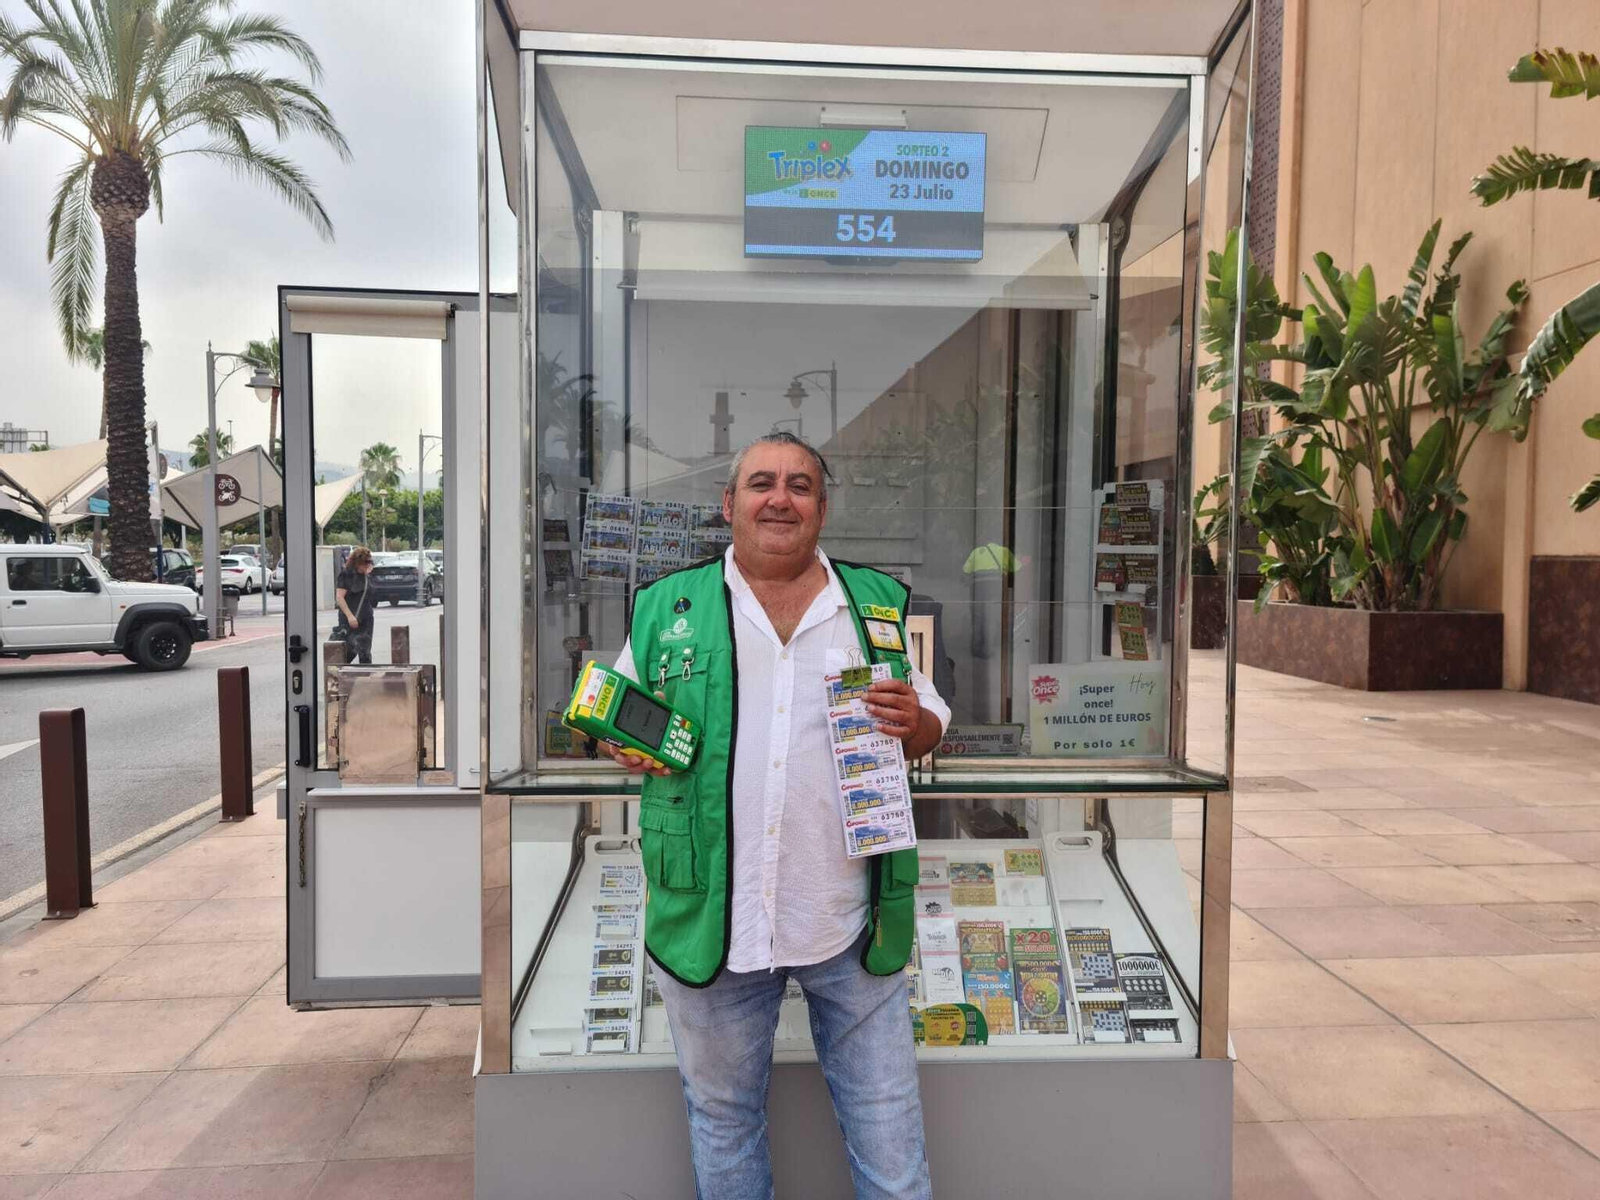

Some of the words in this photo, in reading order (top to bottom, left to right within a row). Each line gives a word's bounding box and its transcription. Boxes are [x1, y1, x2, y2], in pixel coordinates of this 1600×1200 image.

[896, 145, 938, 157] SORTEO
[941, 146, 949, 157] 2
[768, 150, 853, 182] Triplex
[875, 159, 970, 180] DOMINGO
[889, 184, 909, 199] 23
[913, 184, 954, 201] Julio
[836, 214, 897, 243] 554
[1079, 684, 1115, 696] ¡Super
[597, 687, 612, 716] ONCE
[1084, 699, 1114, 709] once!
[1043, 716, 1049, 725] 1
[1052, 713, 1096, 725] MILLÓN
[1099, 714, 1113, 723] DE
[1116, 713, 1151, 723] EUROS
[1054, 741, 1077, 750] Por
[1083, 739, 1113, 749] solo
